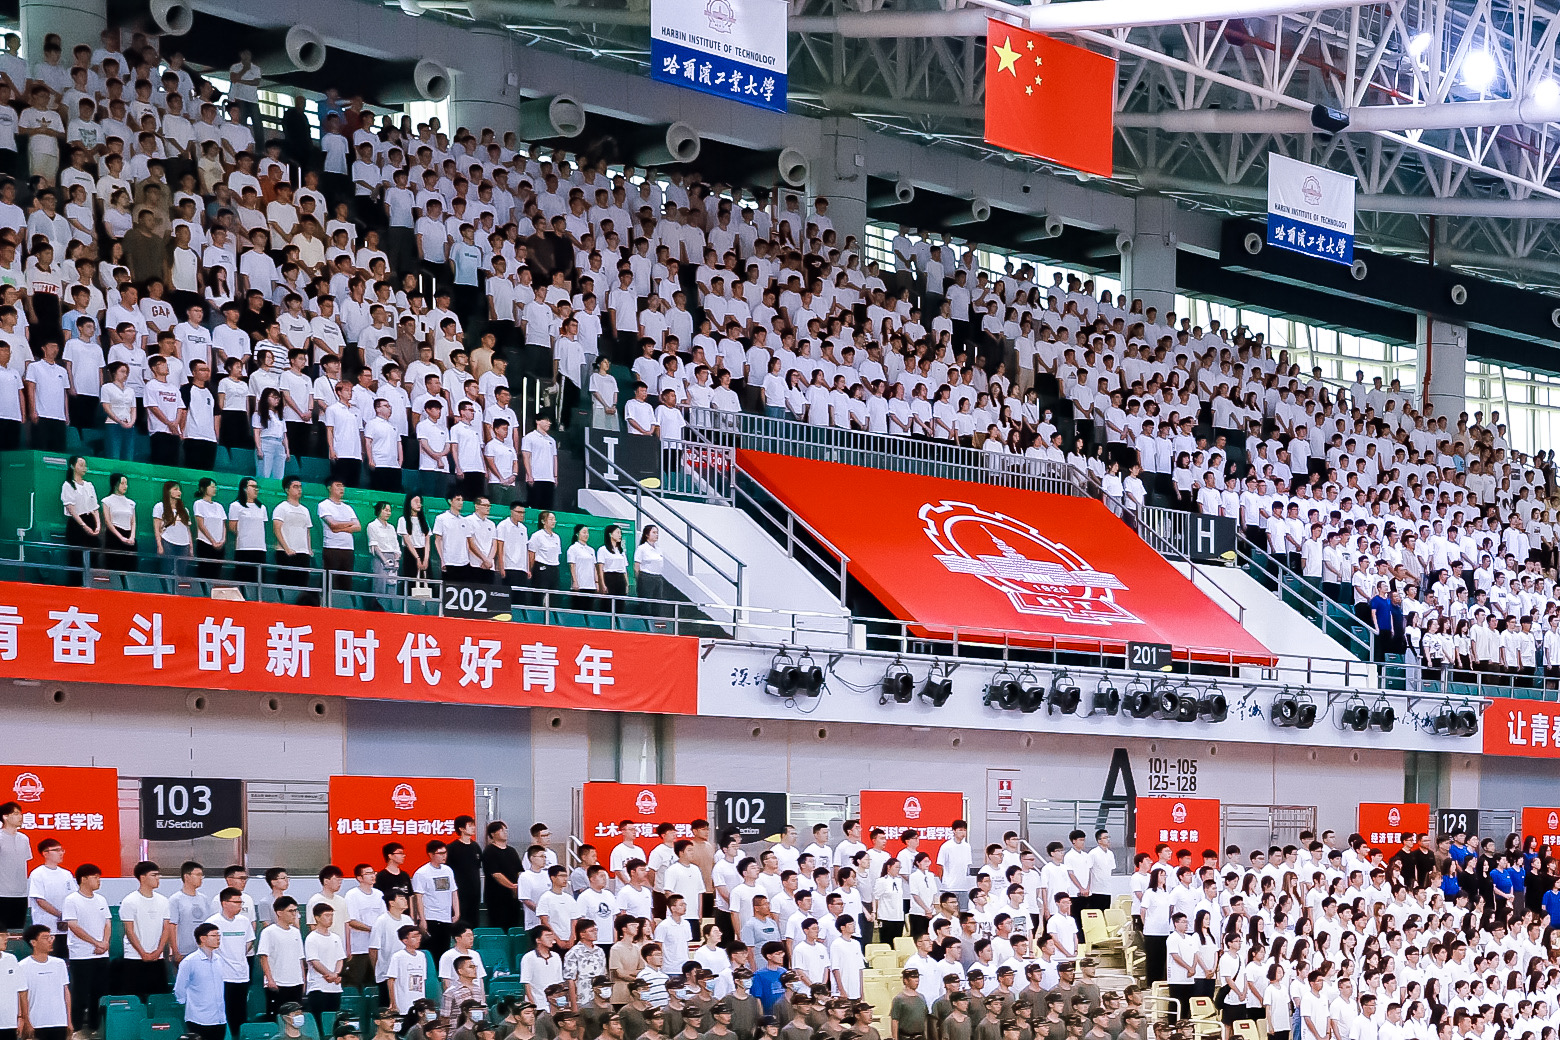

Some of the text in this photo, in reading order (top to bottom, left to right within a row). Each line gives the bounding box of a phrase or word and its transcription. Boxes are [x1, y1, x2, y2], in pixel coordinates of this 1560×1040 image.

[661, 26, 776, 66] HARBIN INSTITUTE OF TECHNOLOGY
[1291, 207, 1313, 220] INSTITUTE
[1313, 213, 1319, 222] OF
[1320, 216, 1348, 230] TECHNOLOGY
[1197, 517, 1215, 554] H
[1032, 584, 1070, 594] 1920
[445, 586, 488, 613] 202
[1036, 596, 1092, 610] HIT
[1133, 645, 1157, 665] 201
[1148, 757, 1198, 775] 101-105
[1148, 775, 1197, 792] 125-128
[153, 784, 212, 816] 103
[725, 797, 766, 824] 102
[16, 812, 104, 831] 息工程学院
[1442, 813, 1467, 834] 128
[1159, 829, 1199, 843] 建筑学院
